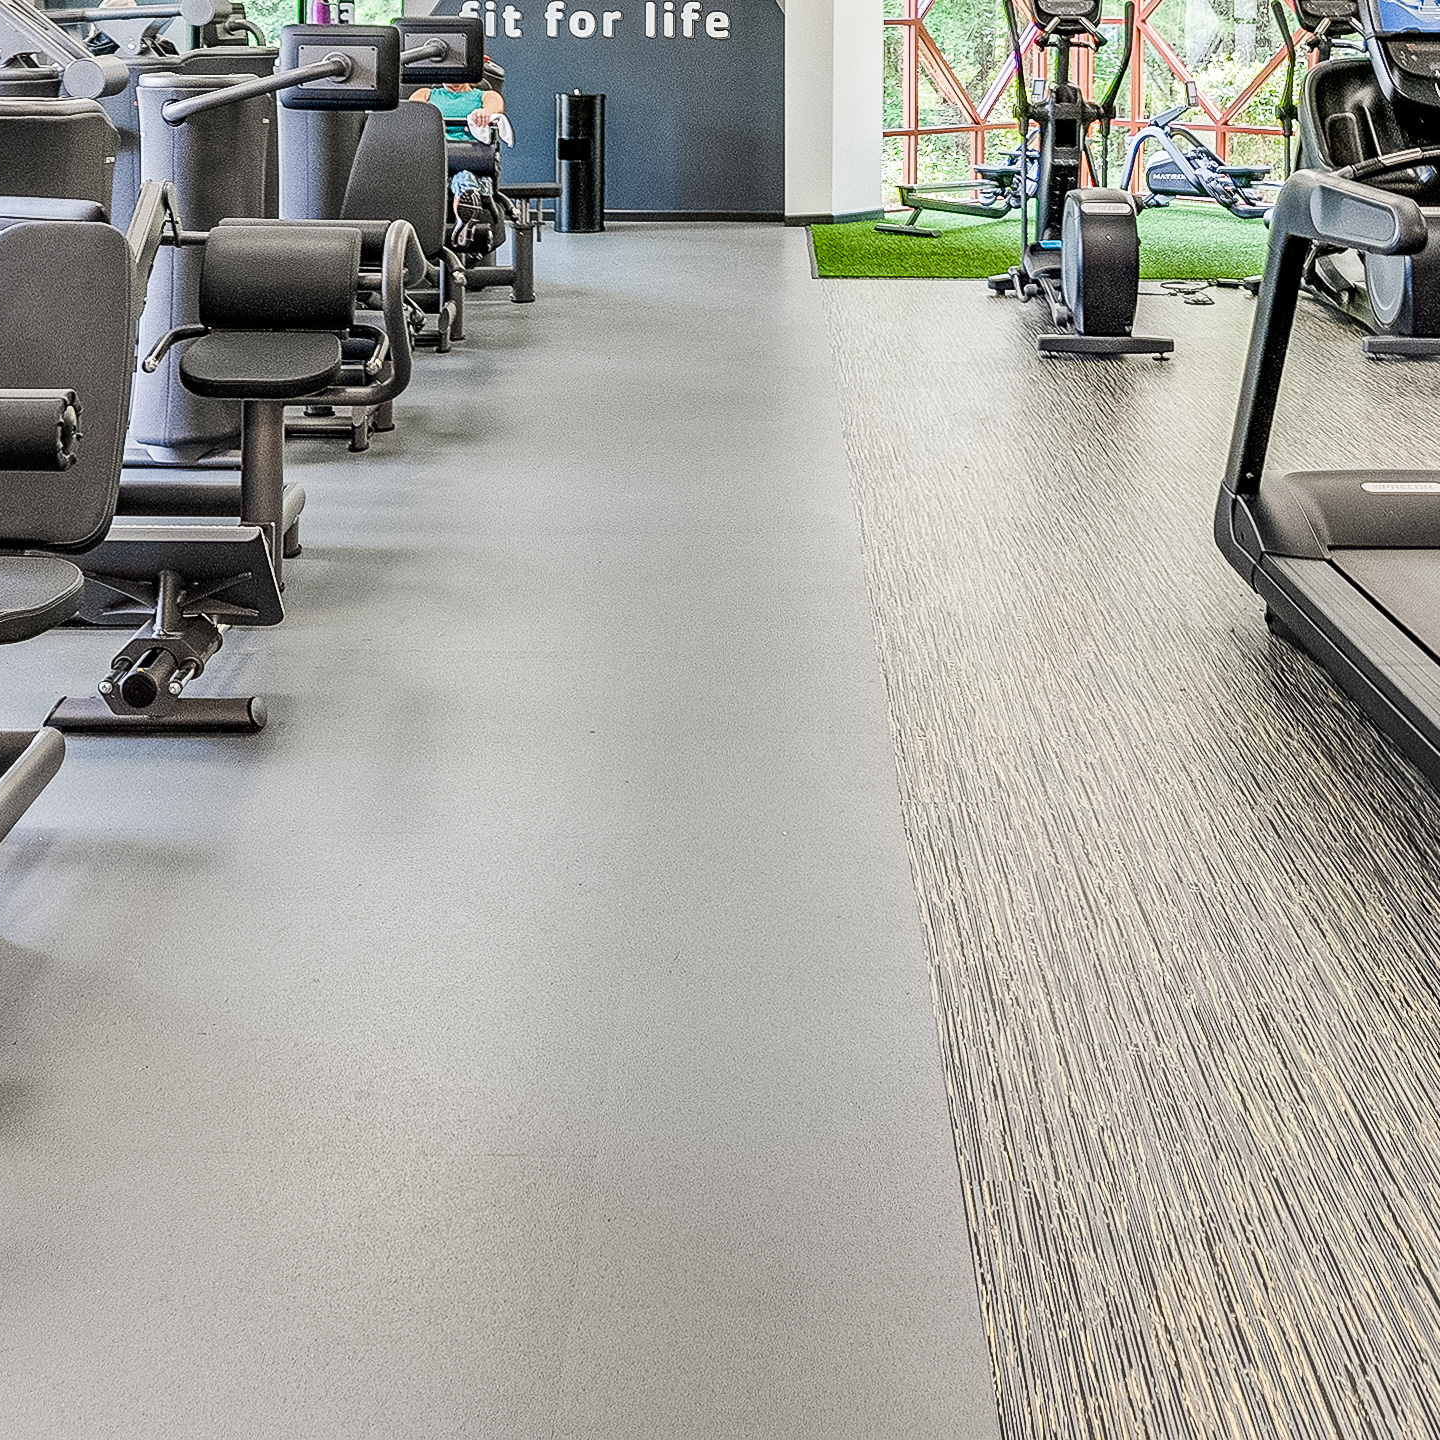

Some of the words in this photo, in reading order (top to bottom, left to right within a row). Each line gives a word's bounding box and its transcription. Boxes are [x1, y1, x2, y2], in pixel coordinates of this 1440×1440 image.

[459, 0, 523, 39] fit
[544, 0, 624, 39] for
[645, 0, 731, 39] life
